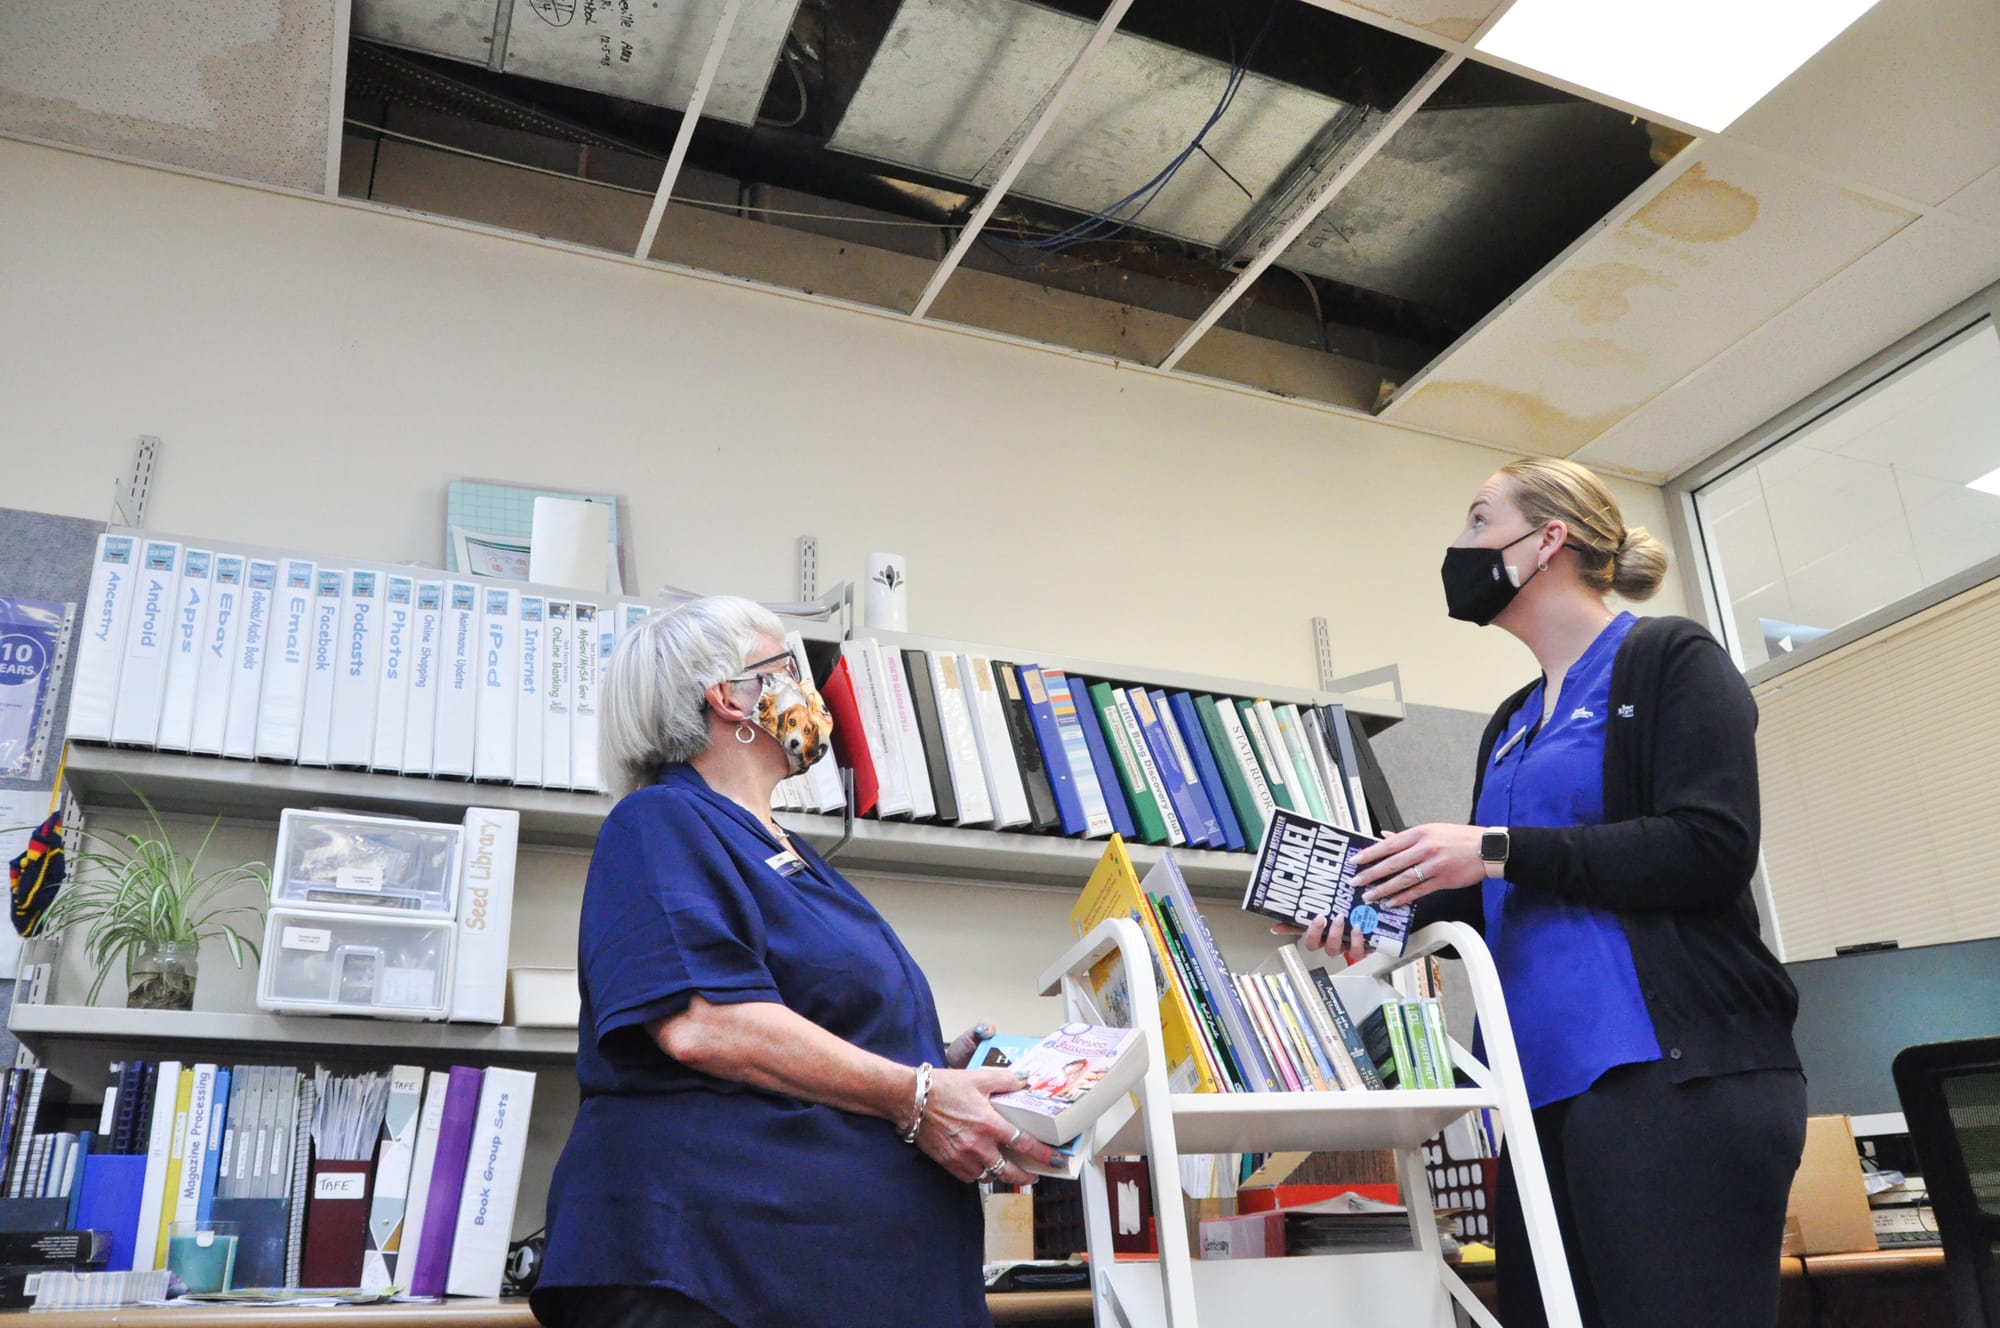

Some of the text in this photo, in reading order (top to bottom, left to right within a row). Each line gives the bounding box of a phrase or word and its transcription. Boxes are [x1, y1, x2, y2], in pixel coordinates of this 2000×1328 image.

[95, 570, 120, 642] Ancestry
[140, 579, 163, 648] Android
[181, 587, 202, 653] Apps
[211, 593, 233, 659] Ebay
[285, 597, 306, 663] Email
[315, 605, 335, 671] Facebook
[2, 643, 33, 662] 10
[243, 646, 259, 670] Books
[350, 603, 369, 677] Podcasts
[387, 610, 406, 680] Photos
[415, 614, 435, 688] Online Shopping
[454, 612, 470, 689] Maintenance Updates
[487, 623, 504, 688] iPad
[523, 628, 538, 695] Internet
[549, 662, 563, 698] Banking
[1119, 702, 1182, 836] Little Bang Discovery Club
[1232, 725, 1254, 766] STATE
[1247, 768, 1275, 813] RECOR
[1264, 850, 1277, 869] TIMES
[1270, 815, 1287, 850] BESTSELLER
[465, 819, 503, 931] Seed Library
[1256, 884, 1267, 903] NEW
[1260, 866, 1271, 885] YORK
[1263, 823, 1318, 917] MICHAEL
[1295, 825, 1350, 927] CONNELLY
[392, 1081, 416, 1091] TAFE
[183, 1071, 211, 1200] Magazine Processing
[474, 1093, 509, 1226] Book Group Sets
[320, 1180, 352, 1191] TAFE
